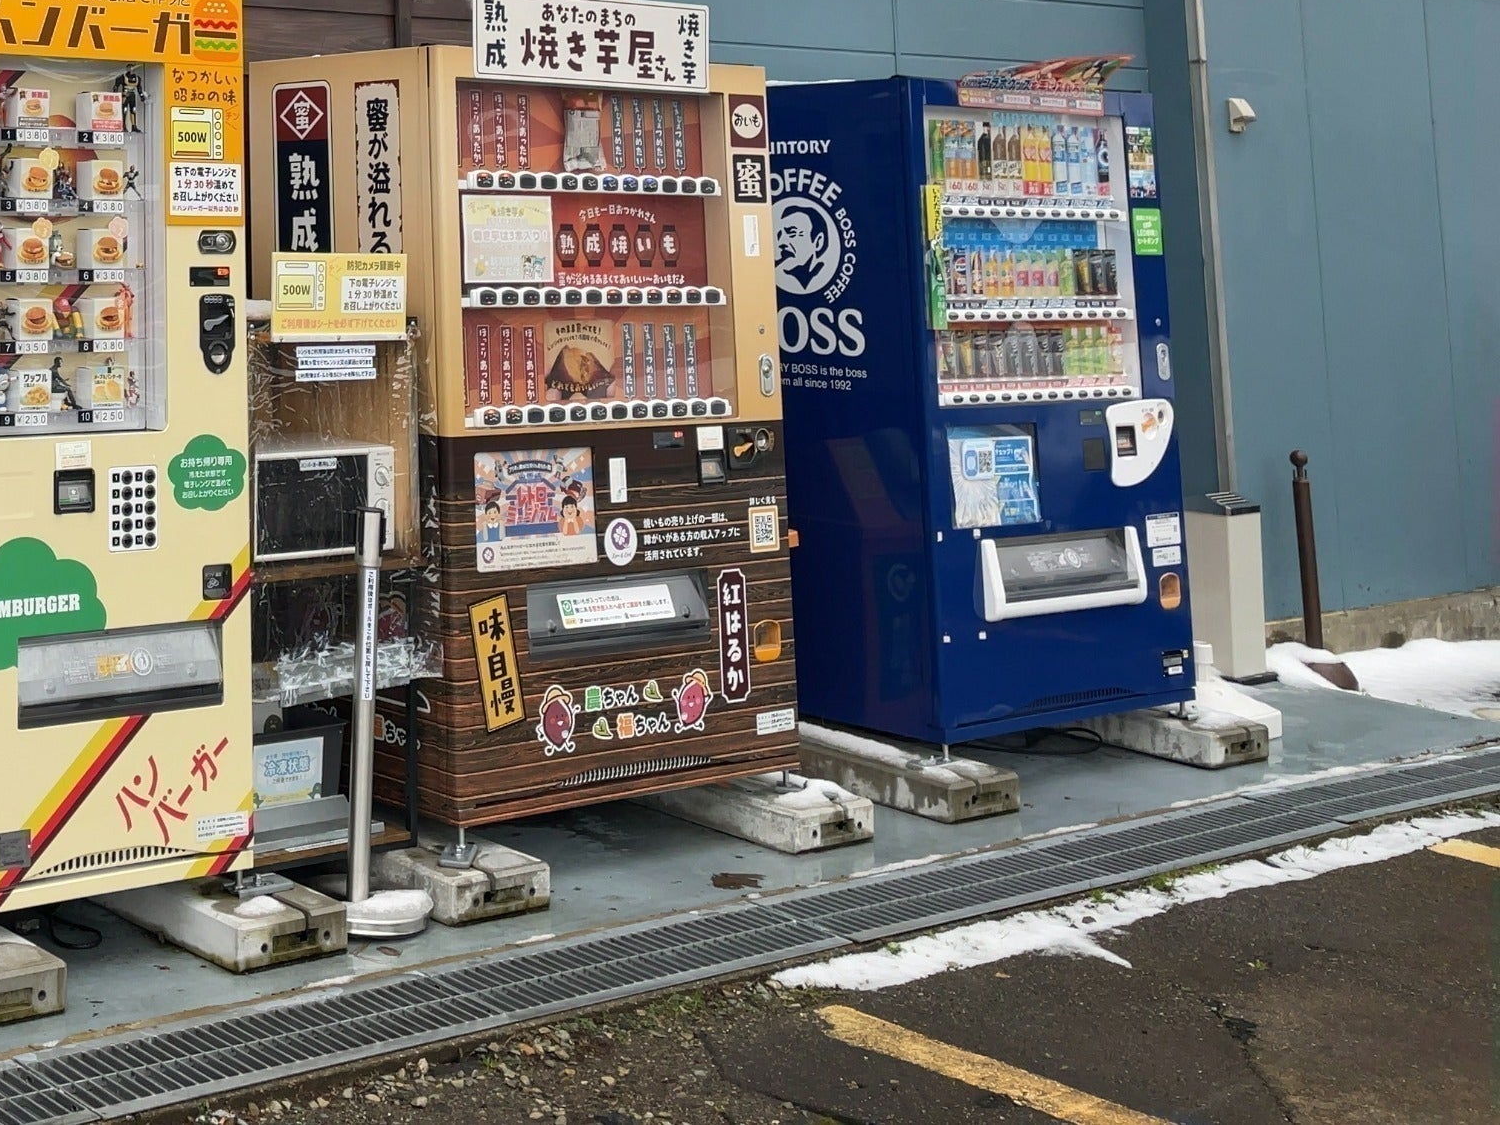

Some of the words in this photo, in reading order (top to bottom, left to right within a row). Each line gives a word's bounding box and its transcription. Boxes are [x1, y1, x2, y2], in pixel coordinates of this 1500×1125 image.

[542, 3, 636, 27] あなたのまちの
[520, 24, 676, 83] 焼き芋屋さん
[677, 12, 701, 84] 焼き芋
[172, 68, 238, 85] なつかしい
[173, 88, 237, 105] 昭和の味
[733, 112, 761, 128] おいも
[19, 131, 48, 140] ¥380
[95, 133, 123, 142] ¥380
[178, 131, 207, 143] 500W
[174, 166, 237, 177] 右下の電子レンジで
[367, 98, 391, 253] 蜜が溢れる
[736, 160, 763, 198] 蜜
[173, 191, 239, 202] お召し上がりください
[288, 152, 320, 252] 熟成
[19, 201, 47, 210] ¥380
[95, 202, 123, 211] ¥380
[578, 205, 656, 224] 今日も一日おつかれさん
[834, 207, 856, 248] BOSS
[18, 271, 47, 280] ¥380
[95, 271, 123, 280] ¥380
[824, 252, 856, 304] COFFEE
[349, 278, 397, 287] 下の電子レンジで
[283, 284, 311, 295] 500W
[343, 301, 402, 311] お召し上がりください
[17, 343, 47, 352] ¥350
[95, 342, 123, 351] ¥380
[791, 364, 818, 374] BOSS
[820, 366, 827, 375] is
[830, 367, 843, 377] the
[846, 367, 867, 378] boss
[23, 374, 48, 382] ワッフル
[793, 377, 803, 386] all
[805, 378, 827, 388] since
[830, 380, 851, 390] 1992
[17, 416, 46, 424] ¥230
[80, 412, 90, 421] 10
[95, 411, 123, 420] ¥250
[722, 582, 744, 692] 紅はるか
[478, 608, 517, 718] 味自慢
[584, 684, 638, 711] 農ちゃん
[617, 712, 670, 740] 福ちゃん
